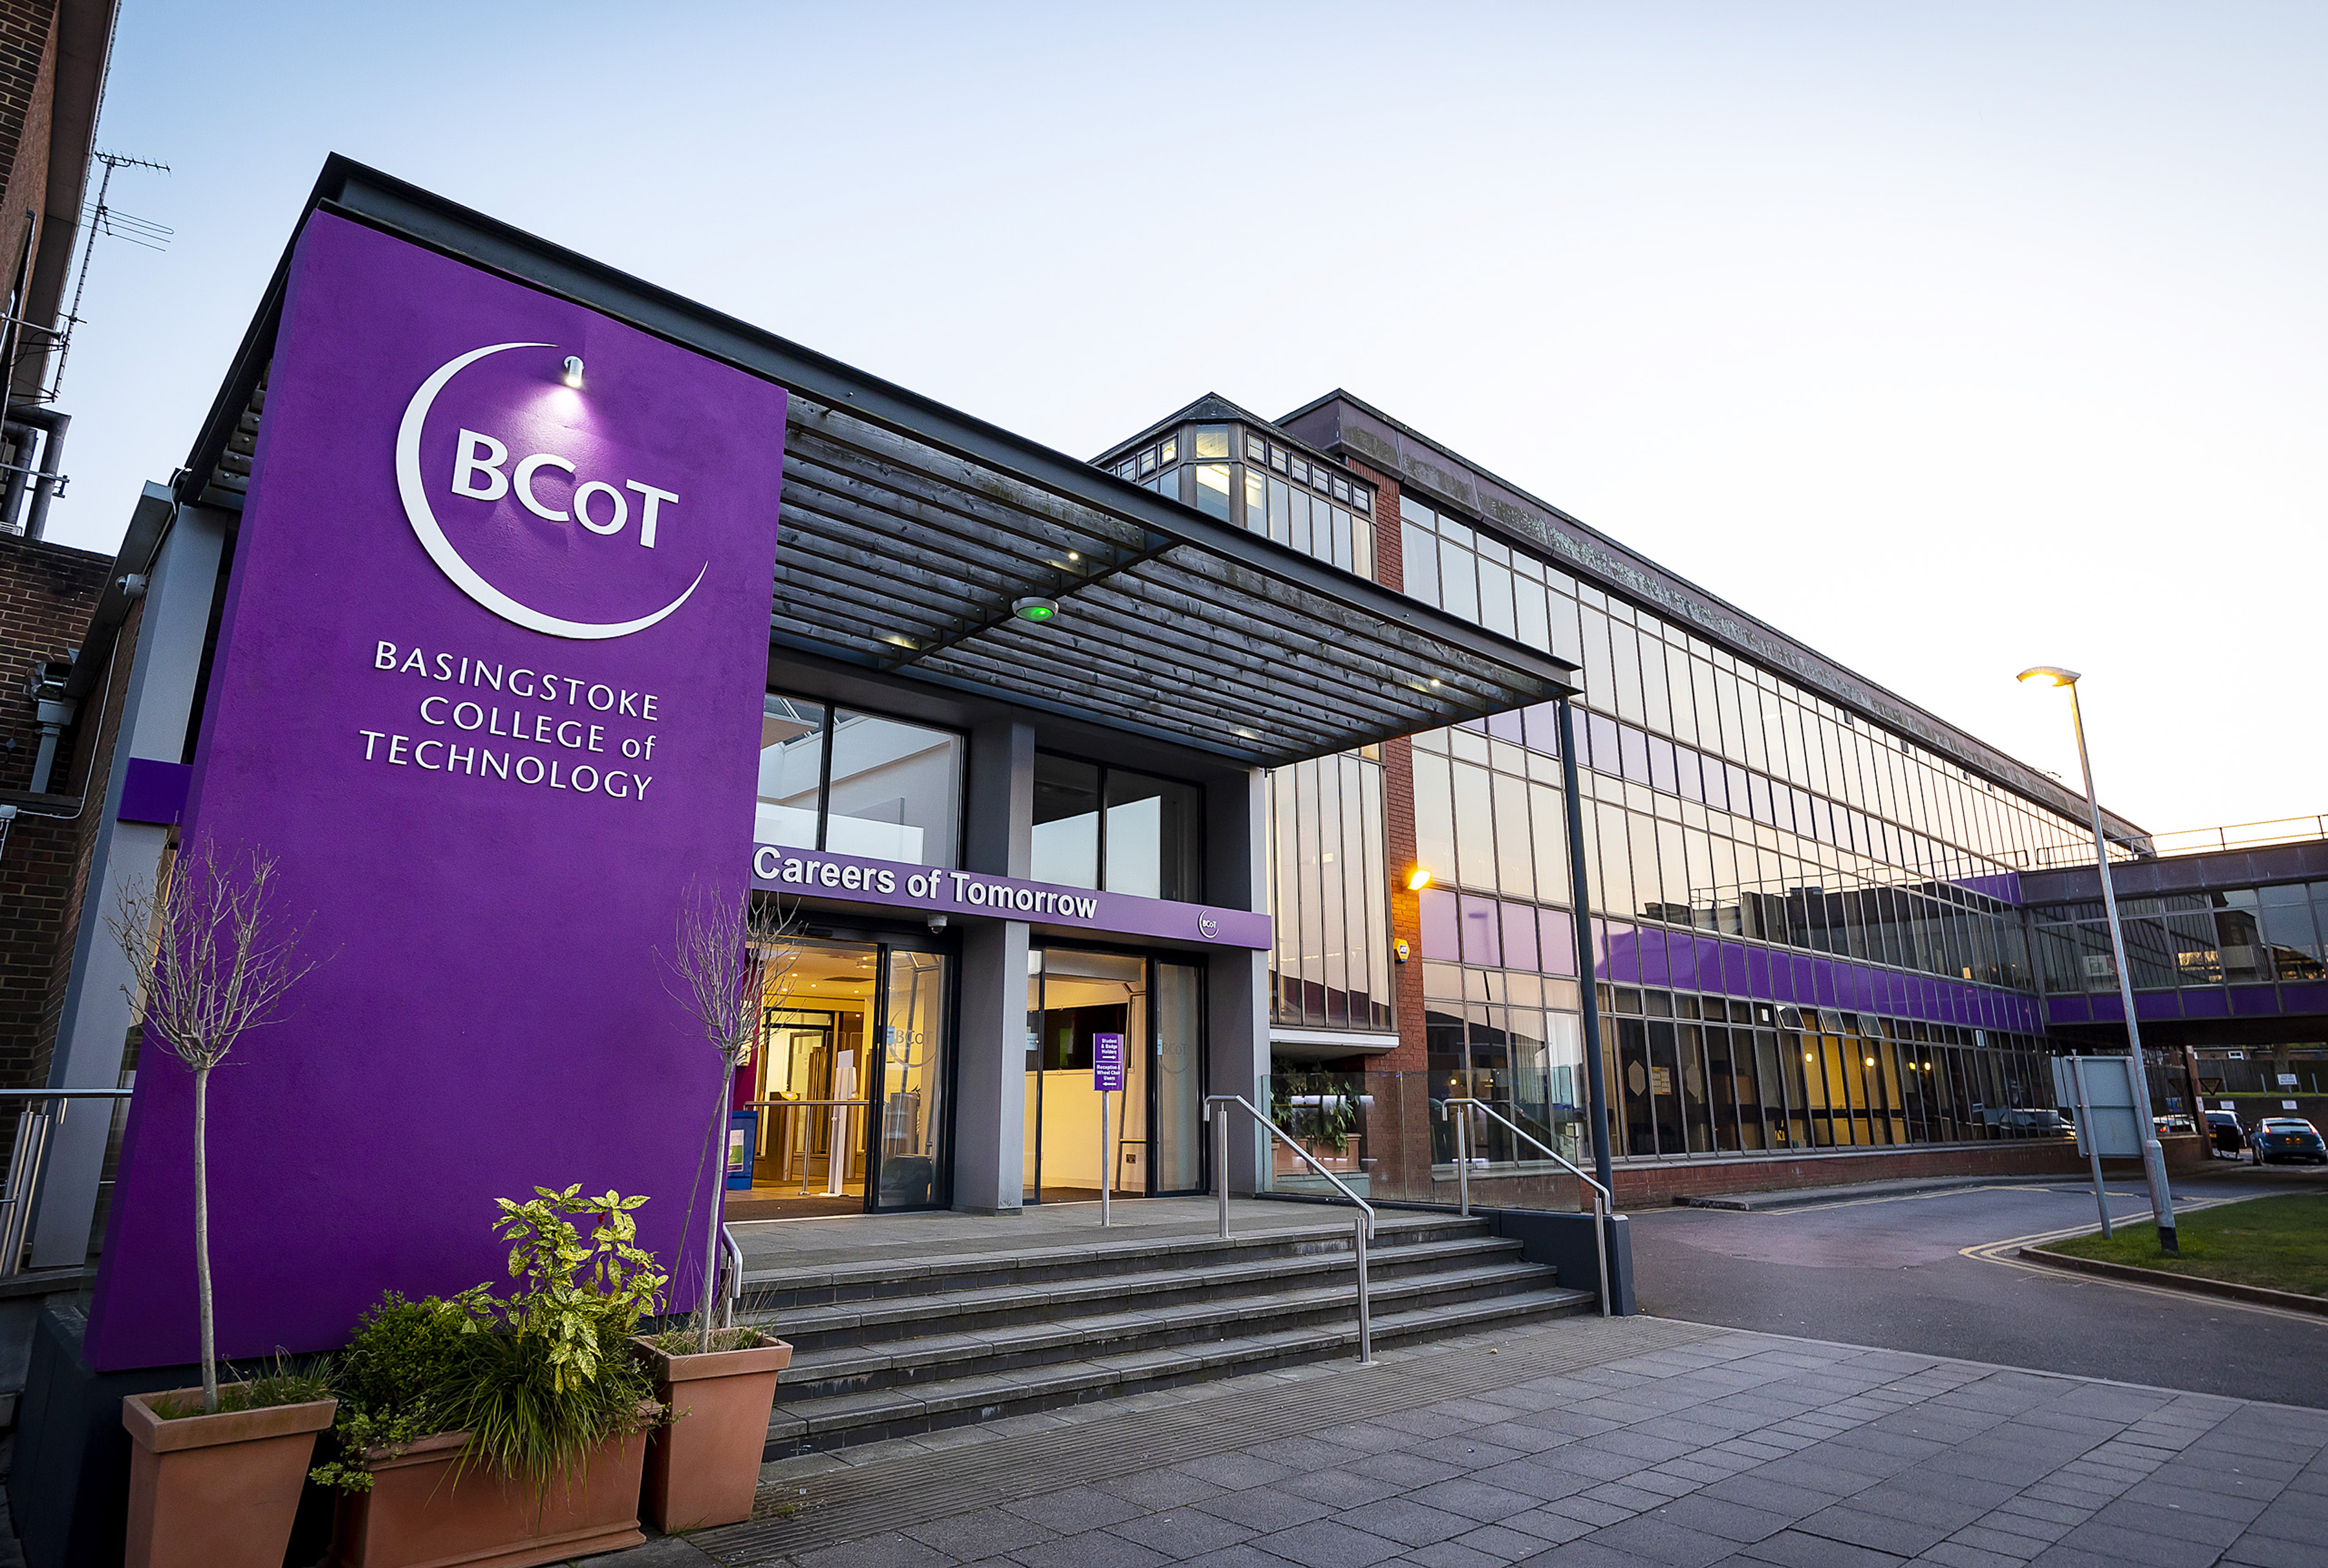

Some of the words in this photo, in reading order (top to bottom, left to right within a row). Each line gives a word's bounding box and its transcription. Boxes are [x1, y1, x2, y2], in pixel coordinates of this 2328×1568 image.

[375, 641, 658, 721] BASINGSTOKE
[420, 696, 605, 753] COLLEGE
[621, 735, 656, 760] of
[360, 730, 652, 800] TECHNOLOGY
[753, 846, 896, 894] Careers
[907, 869, 942, 899] of
[950, 872, 1097, 919] Tomorrow
